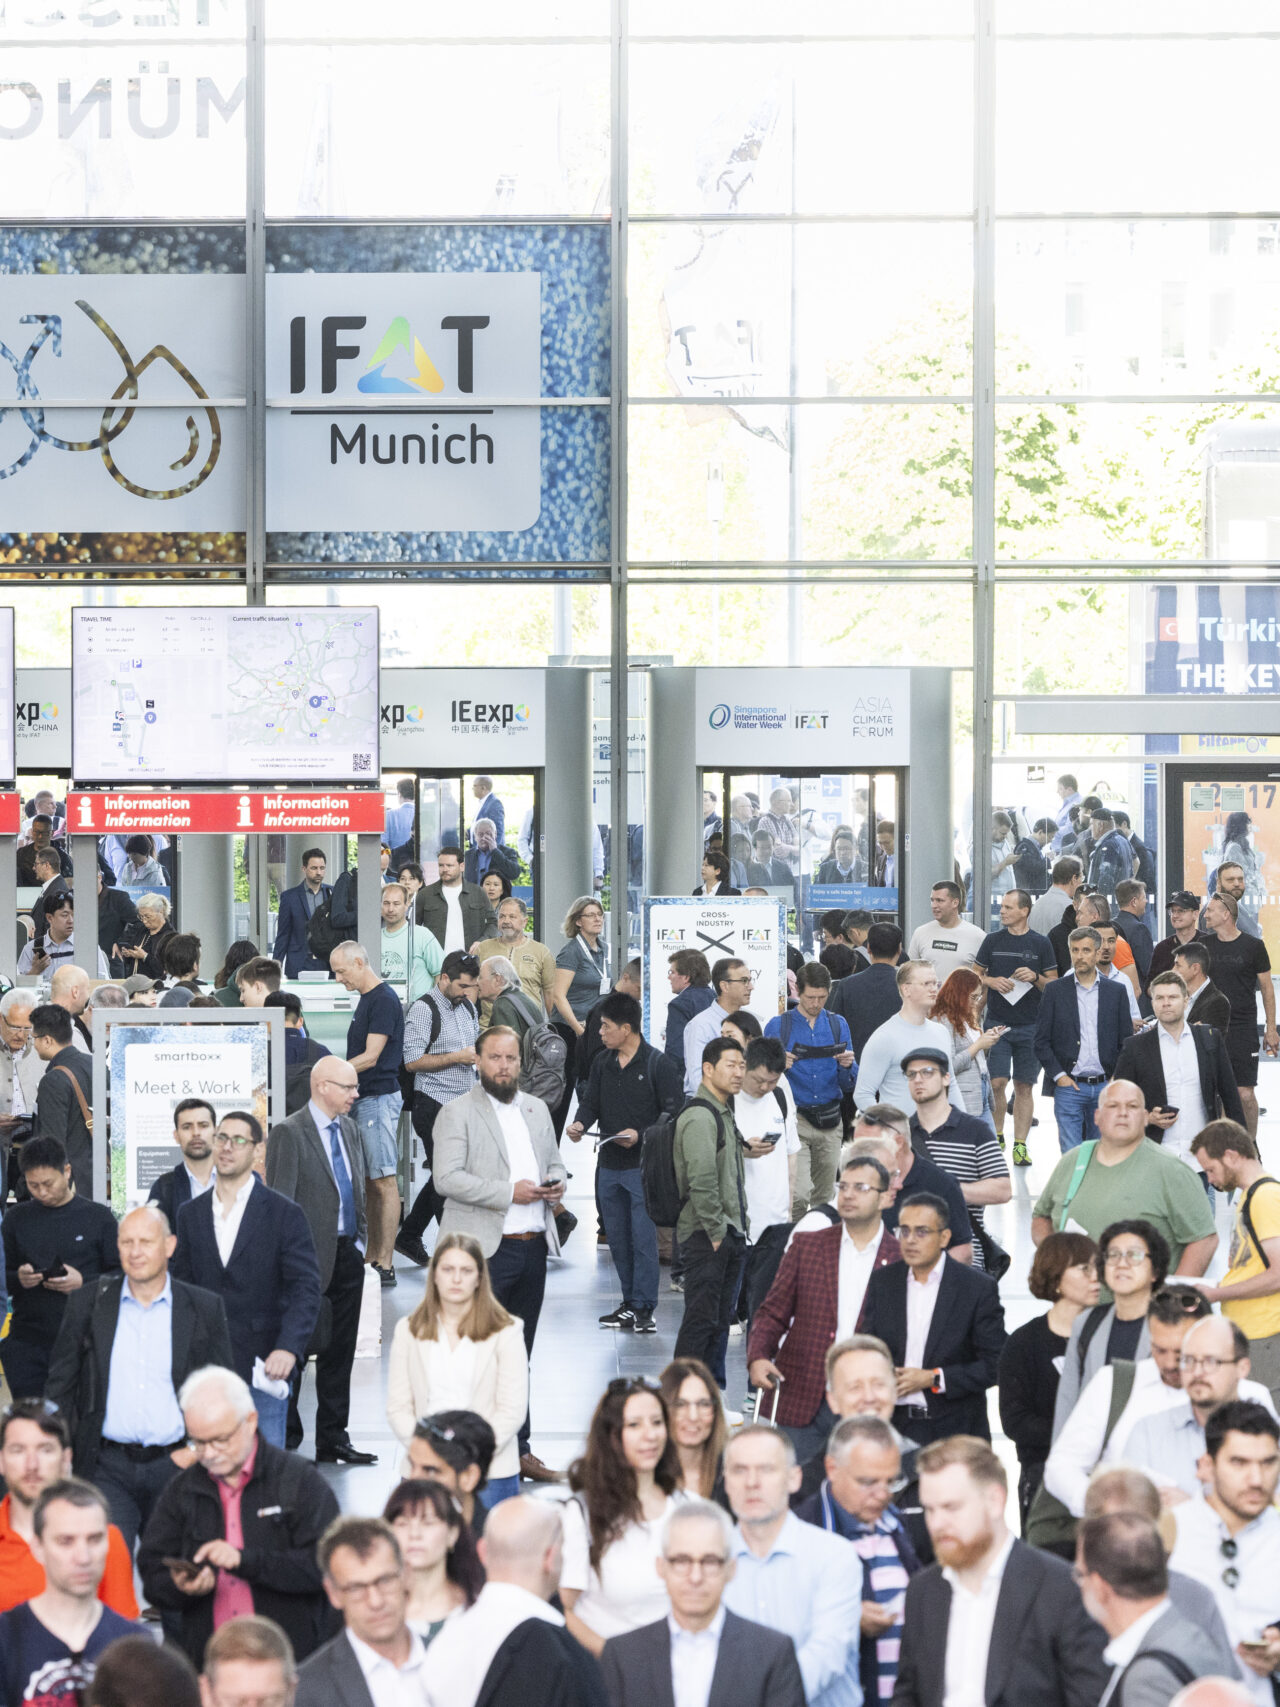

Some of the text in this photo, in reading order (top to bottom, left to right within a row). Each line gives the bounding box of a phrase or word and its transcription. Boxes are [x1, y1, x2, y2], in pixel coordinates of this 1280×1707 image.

[290, 315, 490, 394] IFAT
[330, 422, 494, 465] Munich
[1199, 617, 1280, 641] Türki
[1237, 664, 1280, 687] KE
[734, 705, 777, 714] Singapore
[853, 697, 893, 712] ASIA
[451, 700, 530, 728] IEexpo
[734, 713, 786, 721] International
[853, 715, 893, 724] CLIMATE
[451, 724, 500, 734] 中国环博会
[734, 721, 783, 729] Water Week
[795, 715, 828, 729] IFAT
[852, 727, 894, 737] FORUM
[104, 796, 190, 810] Information
[263, 795, 349, 810] Information
[105, 813, 191, 827] Information
[264, 813, 350, 827] Information
[657, 929, 685, 940] IFAT
[742, 929, 771, 940] IFAT
[154, 1052, 221, 1062] smartboxx
[134, 1080, 241, 1095] Meet & Work
